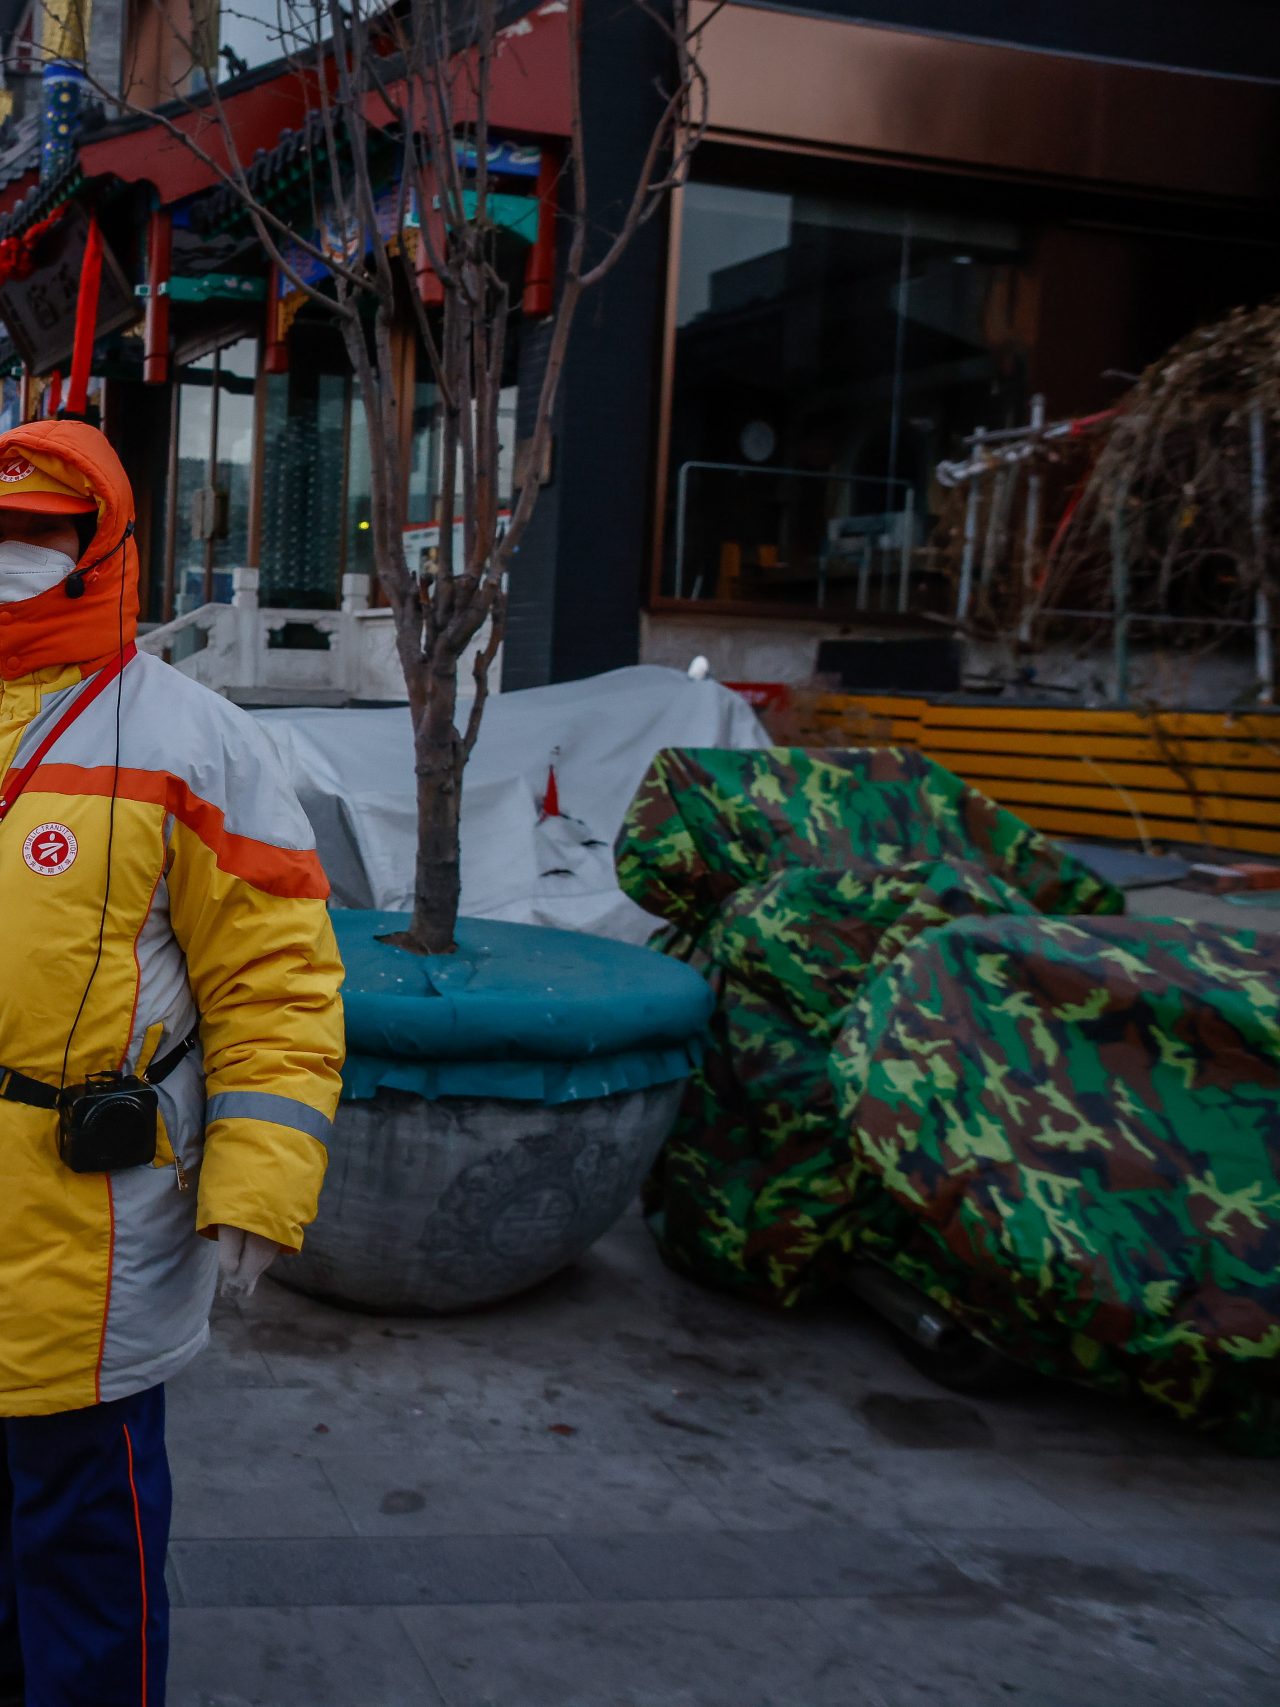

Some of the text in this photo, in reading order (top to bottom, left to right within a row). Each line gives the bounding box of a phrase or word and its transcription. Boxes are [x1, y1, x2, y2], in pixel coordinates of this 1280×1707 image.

[25, 824, 77, 856] PUBLIC TRANSIT GUIDE
